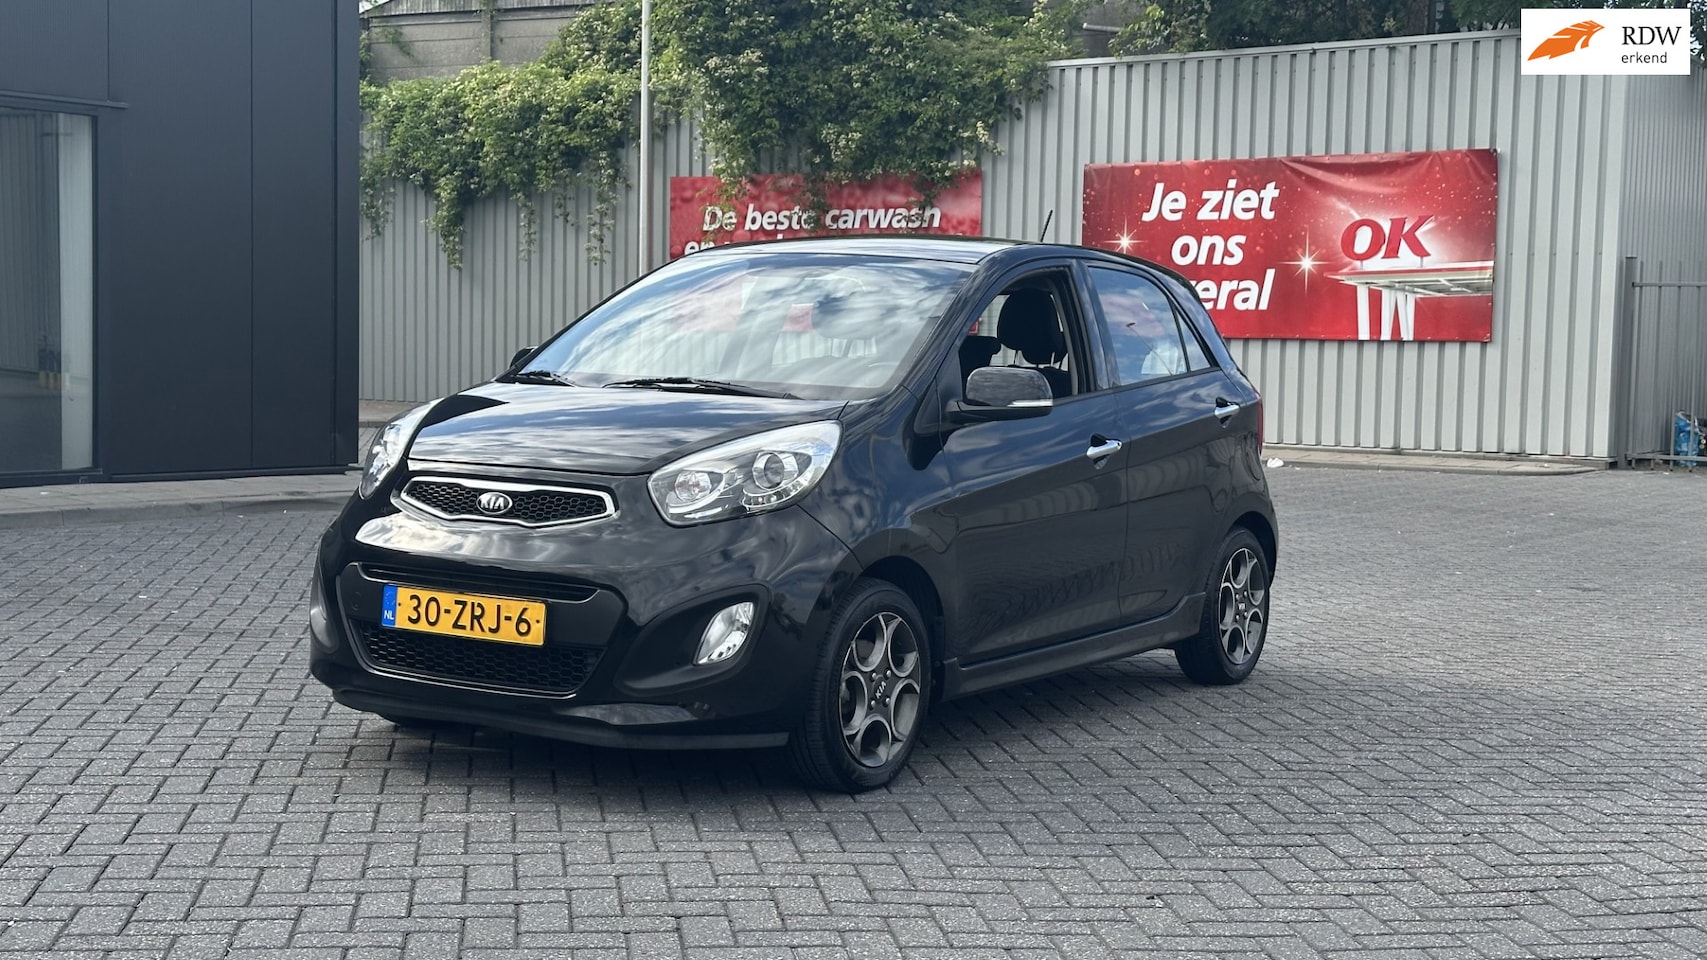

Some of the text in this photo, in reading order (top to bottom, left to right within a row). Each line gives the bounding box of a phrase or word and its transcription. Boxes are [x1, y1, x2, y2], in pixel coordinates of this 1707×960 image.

[1142, 178, 1280, 222] Je ziet
[702, 204, 737, 231] De
[825, 206, 941, 229] carwash
[1170, 233, 1246, 266] ons
[1340, 214, 1433, 261] OK
[480, 493, 505, 510] KIA
[383, 609, 395, 620] NL
[407, 593, 532, 637] 30-ZRJ-6
